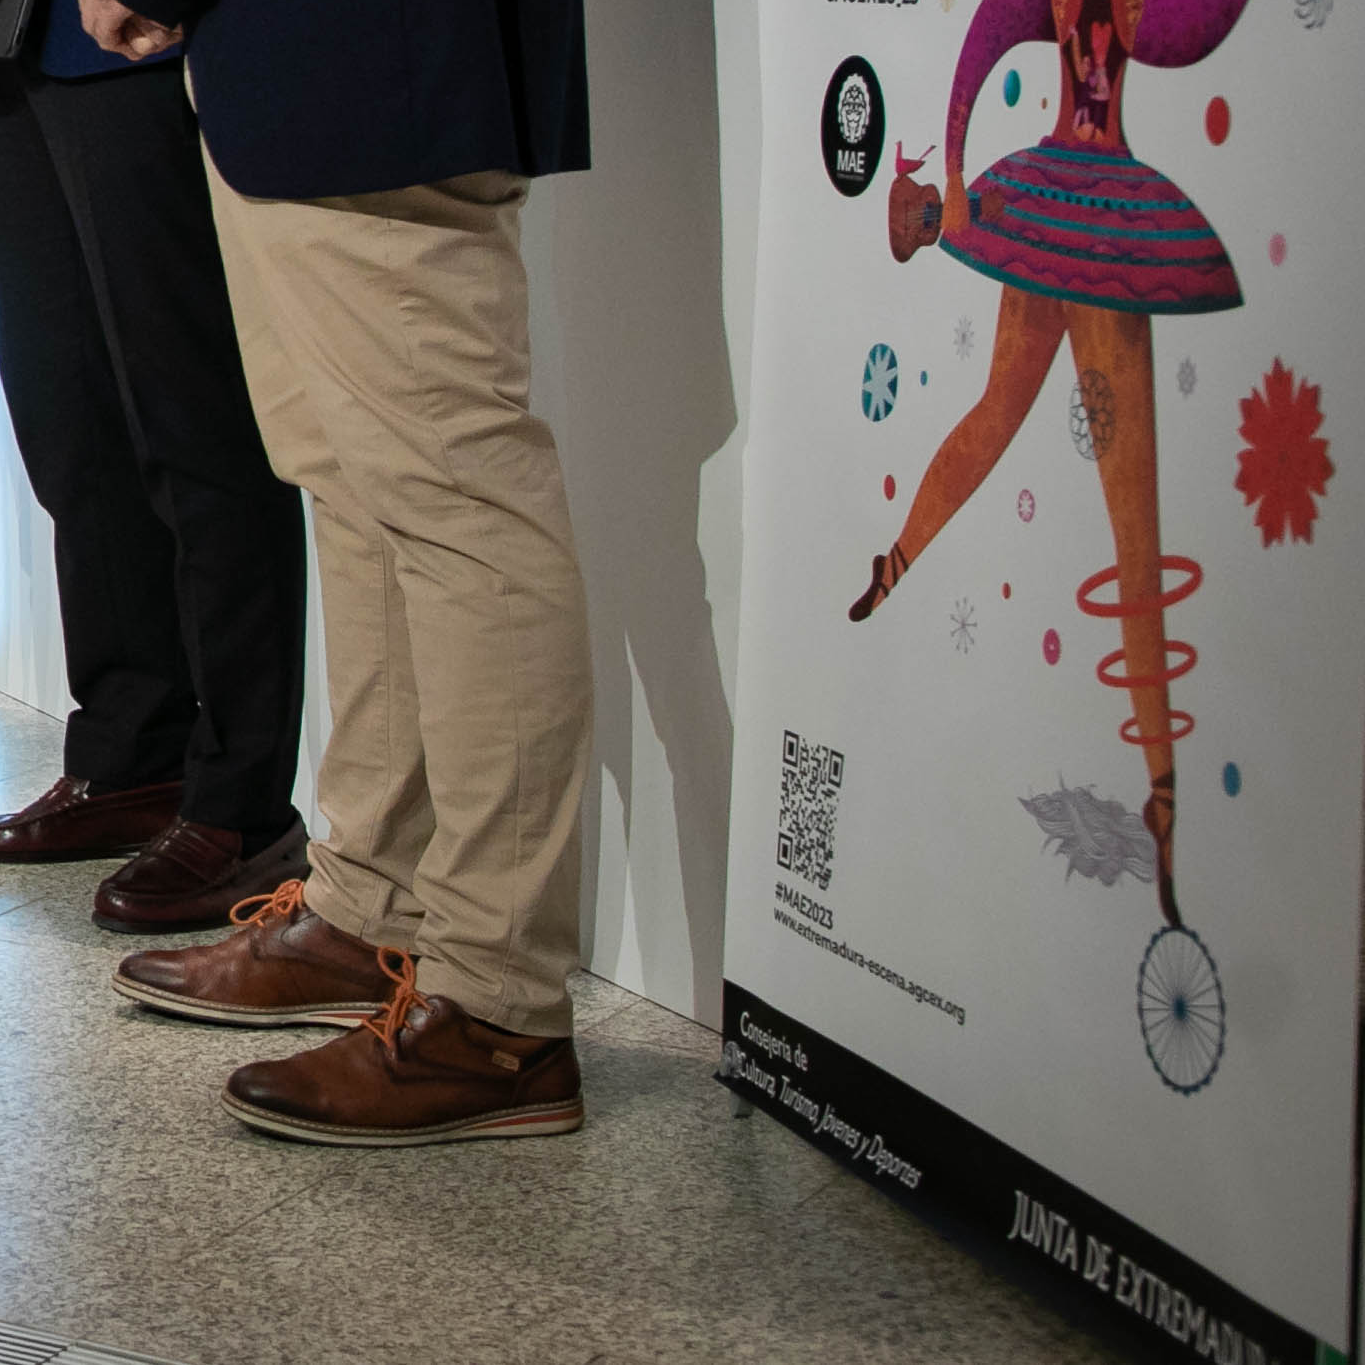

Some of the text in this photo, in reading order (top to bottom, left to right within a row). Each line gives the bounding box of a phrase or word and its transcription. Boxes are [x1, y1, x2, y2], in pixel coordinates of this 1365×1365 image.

[836, 149, 866, 174] MAE
[774, 881, 834, 930] #MAE2023
[794, 1043, 809, 1072] de
[852, 1136, 870, 1160] y
[866, 1134, 923, 1189] Deportes
[1007, 1189, 1078, 1272] JUNTA
[1083, 1235, 1112, 1292] DE
